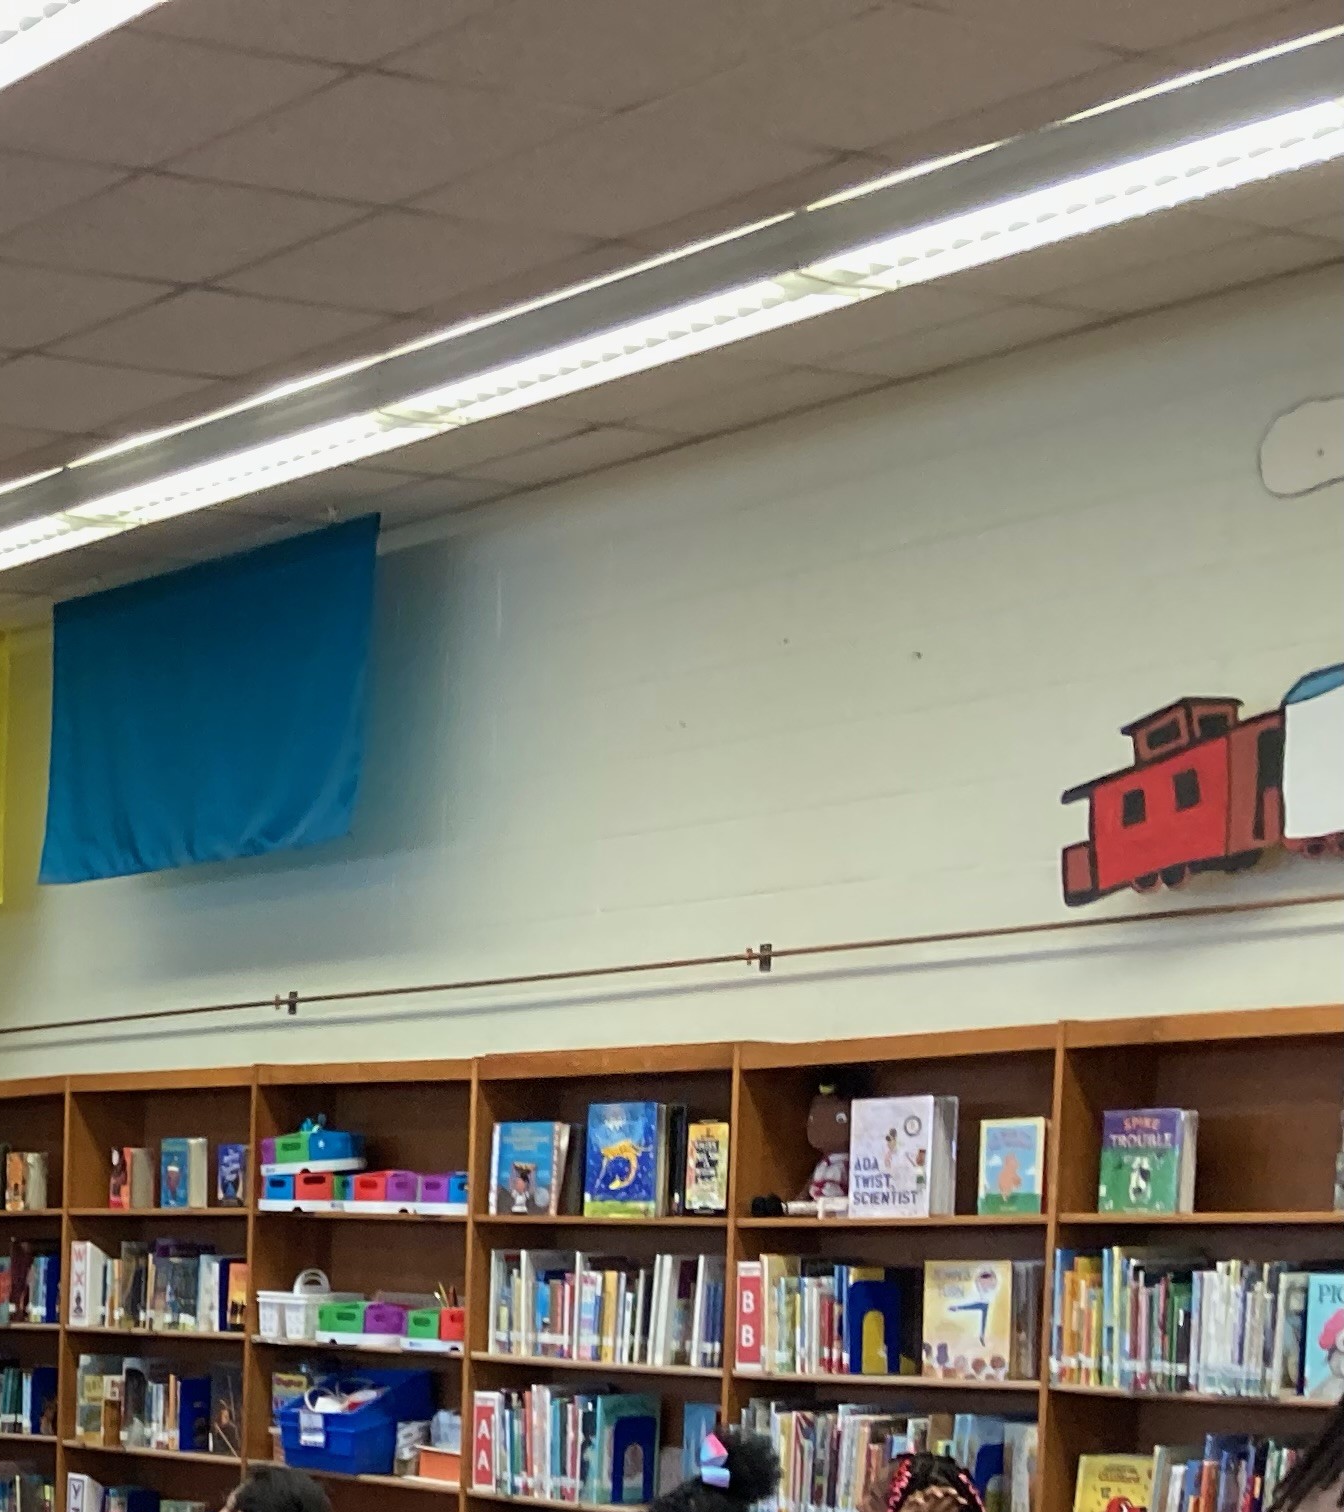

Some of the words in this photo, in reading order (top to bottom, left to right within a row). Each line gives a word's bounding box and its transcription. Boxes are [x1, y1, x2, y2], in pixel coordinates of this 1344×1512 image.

[1109, 1133, 1172, 1148] TROUBLE
[854, 1156, 879, 1171] ADA
[853, 1190, 917, 1206] SCIENTIST
